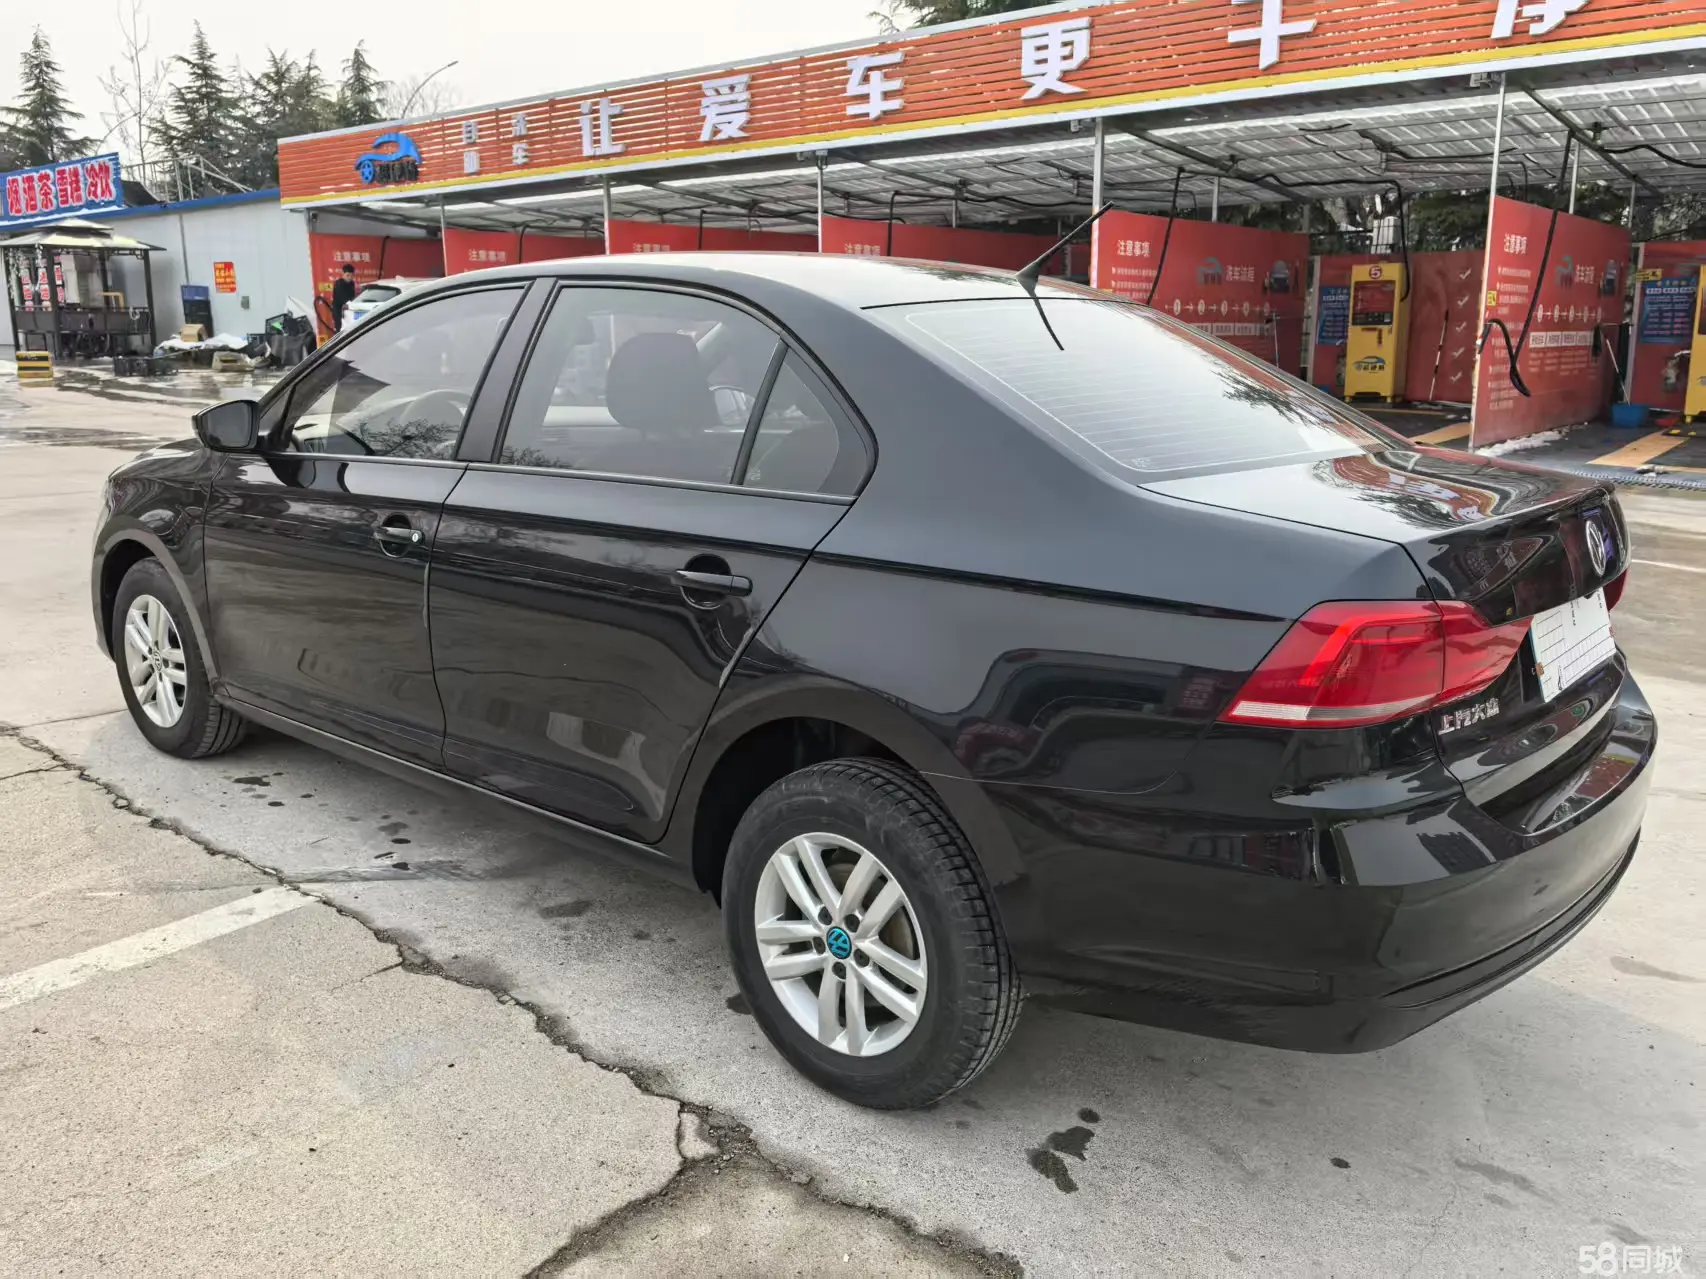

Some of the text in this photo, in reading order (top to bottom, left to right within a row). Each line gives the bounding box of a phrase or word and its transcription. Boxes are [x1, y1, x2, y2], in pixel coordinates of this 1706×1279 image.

[1117, 239, 1151, 257] 注意事项
[1503, 233, 1528, 255] 注意事项
[1369, 266, 1381, 279] 5
